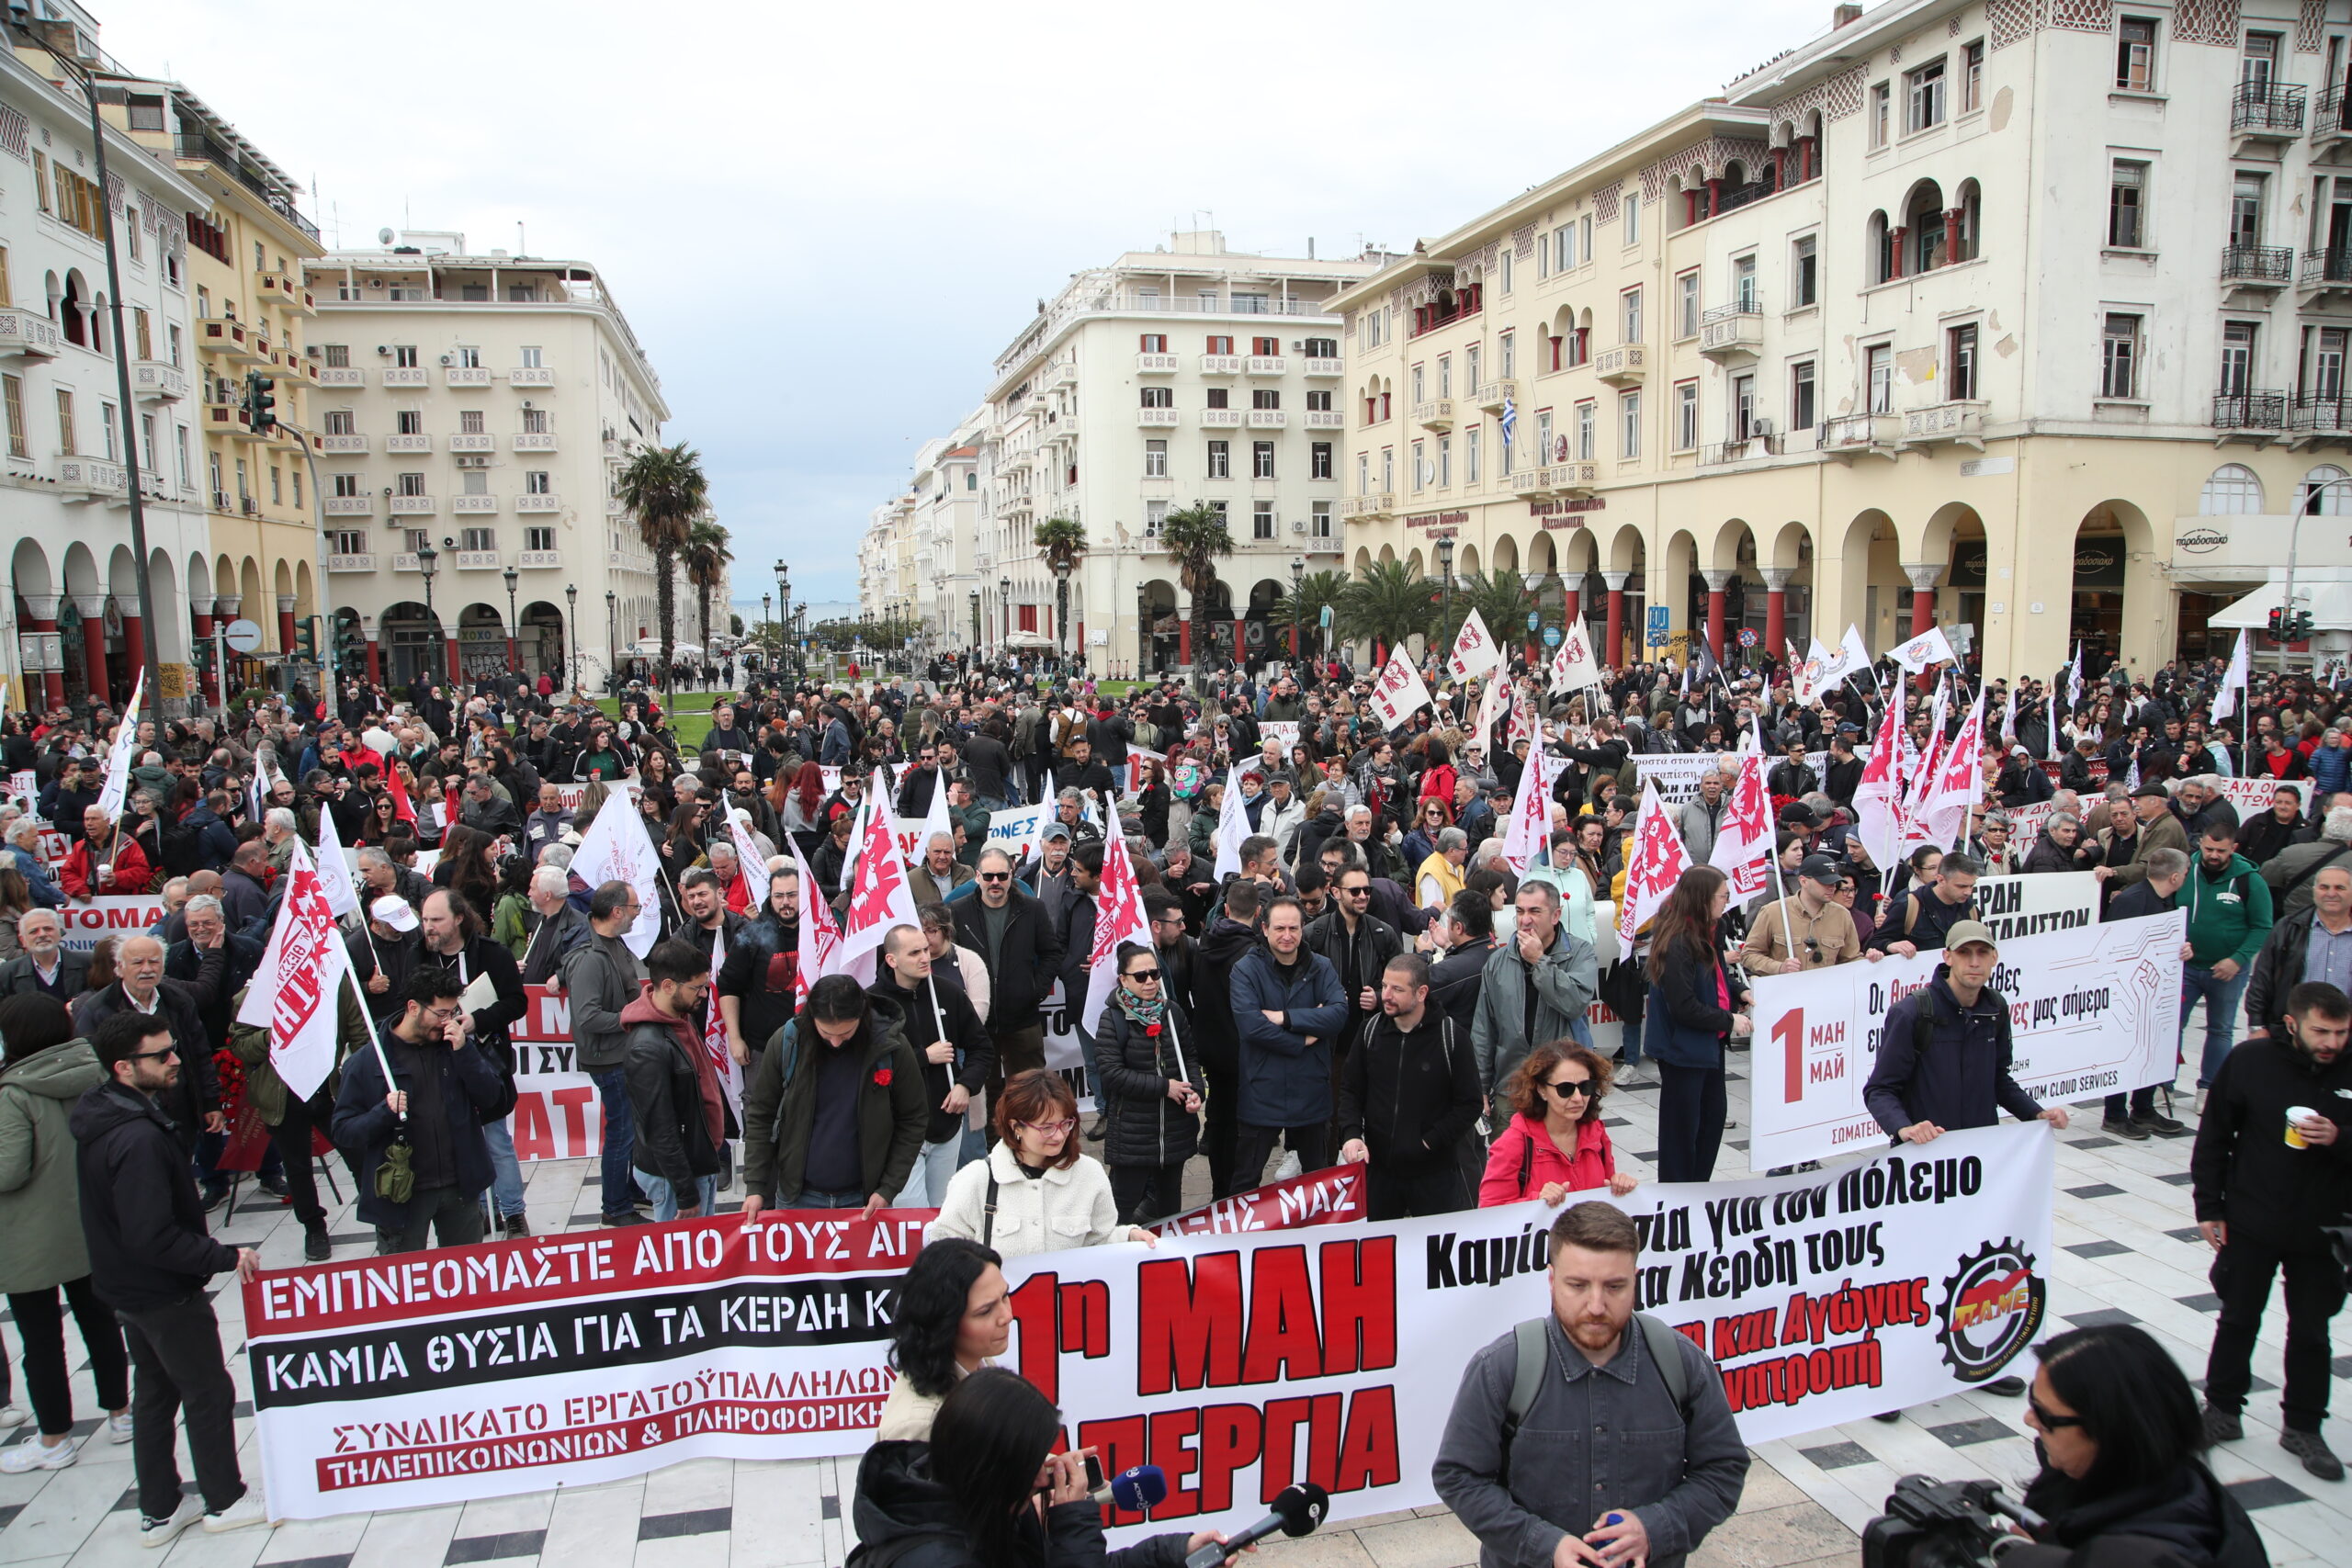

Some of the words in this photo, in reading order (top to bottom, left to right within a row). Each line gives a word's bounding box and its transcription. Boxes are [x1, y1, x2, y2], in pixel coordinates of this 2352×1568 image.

[2176, 534, 2228, 547] παραδοσιακό
[1670, 758, 1695, 766] στον
[1973, 880, 2022, 917] ΕΡΔΗ
[1869, 982, 1884, 1016] Οι
[2033, 995, 2058, 1029] μας
[2062, 984, 2109, 1021] σήμερα
[1771, 1007, 1804, 1104] 1
[1810, 1021, 1845, 1048] ΜΑΗ
[1810, 1052, 1845, 1085] МАЙ
[2050, 1078, 2076, 1098] CLOUD
[2079, 1070, 2119, 1092] SERVICES
[1705, 1195, 1764, 1255] για
[1773, 1182, 1830, 1226] τον
[261, 1239, 616, 1321] ΕΜΠΝΕΟΜΑΣΤΕ
[633, 1227, 723, 1276] ΑΠΟ
[740, 1221, 850, 1263] ΤΟΥΣ
[1278, 1176, 1355, 1224] ΜΑΣ
[1679, 1235, 1798, 1302] Κέρδη
[1804, 1221, 1884, 1275] τους
[1137, 1235, 1397, 1396] ΜΑΗ
[1713, 1306, 1778, 1361] και
[1781, 1277, 1930, 1346] Αγώνας
[266, 1341, 410, 1392] ΚΑΜΙΑ
[426, 1321, 559, 1373] ΘΥΣΙΑ
[574, 1311, 641, 1356] ΓΙΑ
[654, 1304, 706, 1346] ΤΑ
[719, 1292, 850, 1334] ΚΕΡΔΗ
[334, 1403, 548, 1453] ΣΥΝΔΙΚΑΤΟ
[327, 1427, 628, 1487] ΤΗΛΕΠΙΚΟΙΝΩΝΙΩΝ
[641, 1421, 663, 1446] &
